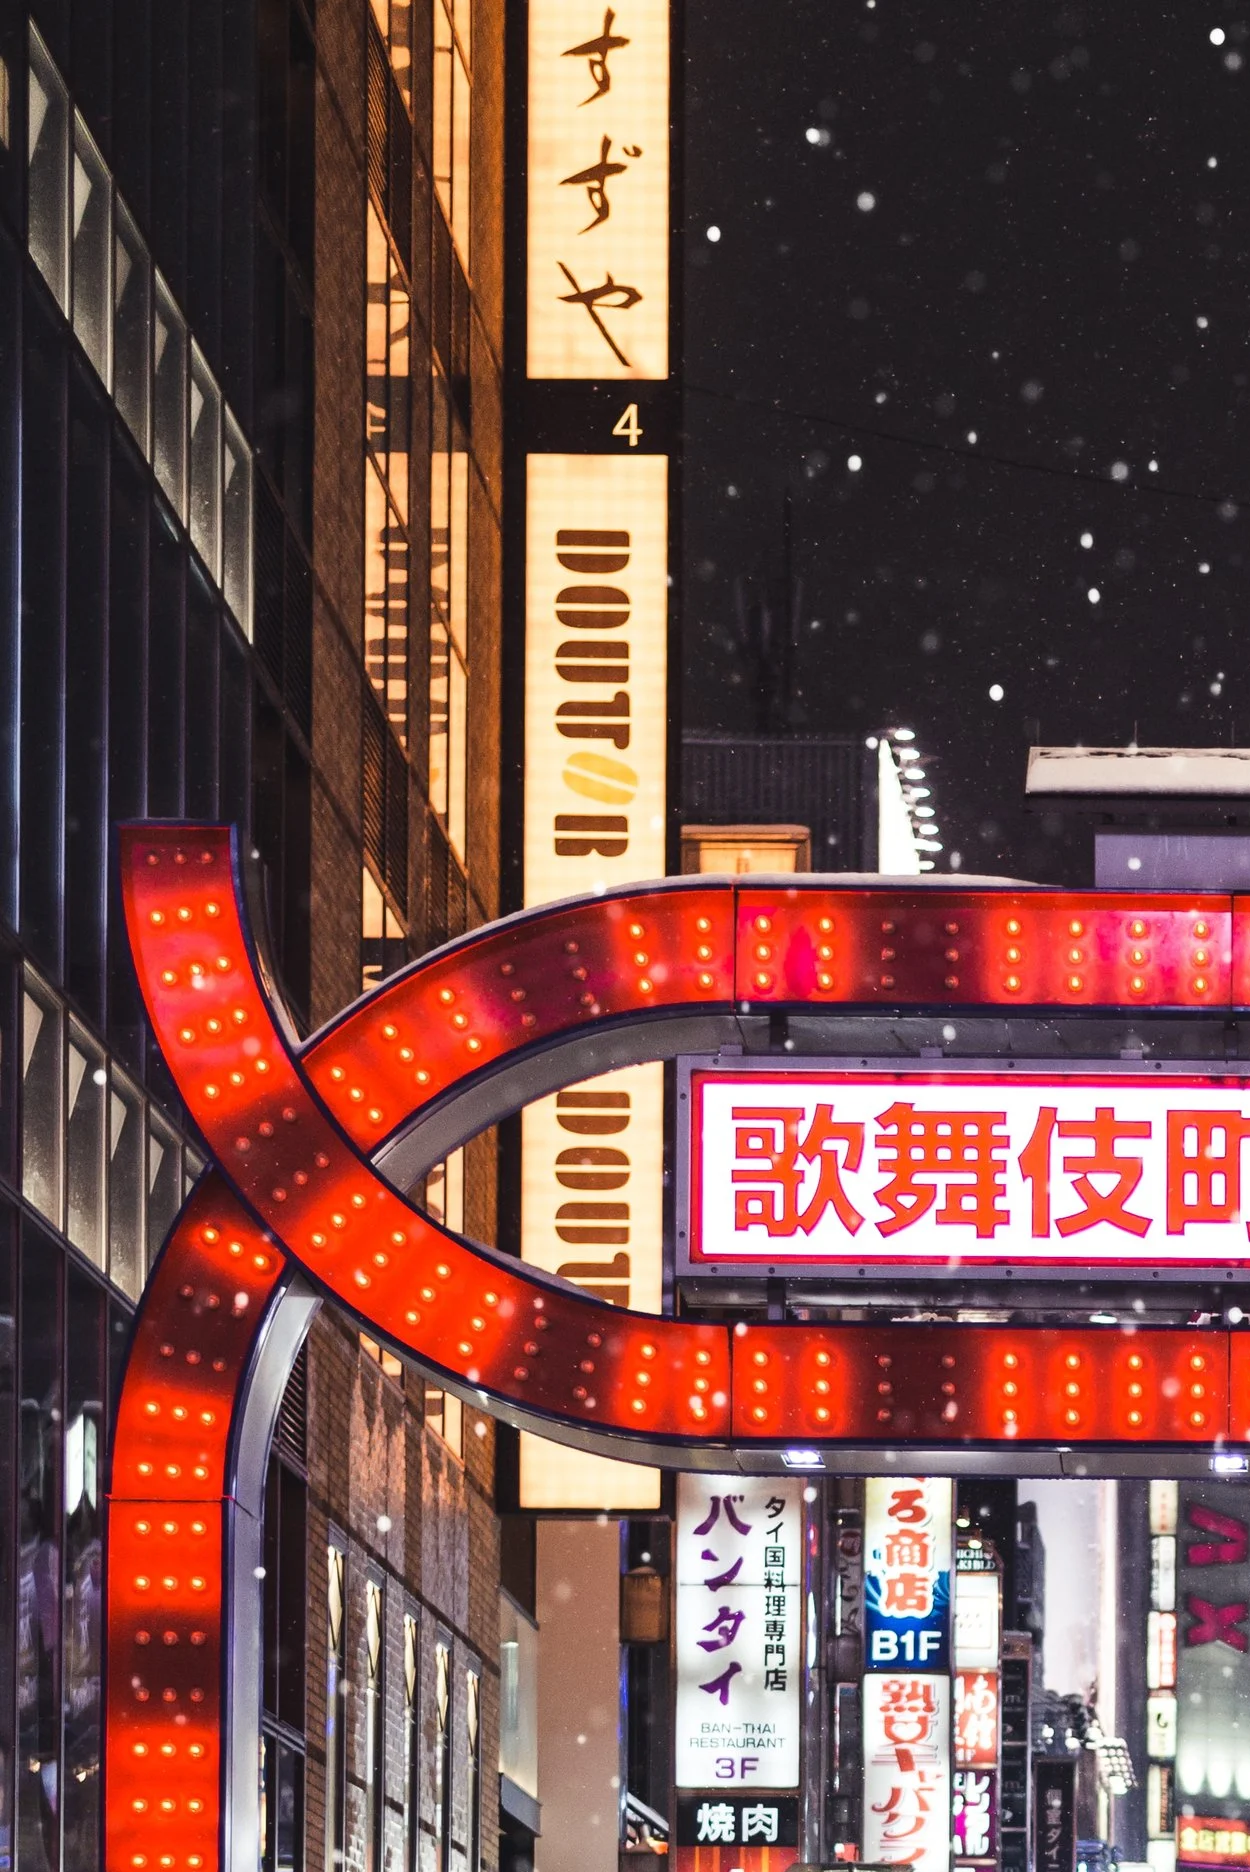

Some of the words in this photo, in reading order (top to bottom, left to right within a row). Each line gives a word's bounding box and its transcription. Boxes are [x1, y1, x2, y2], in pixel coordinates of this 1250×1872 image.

[612, 403, 643, 447] 4
[555, 529, 638, 857] DOUTOR
[884, 1476, 936, 1619] ろ商店
[692, 1494, 753, 1706] バンタイ
[763, 1495, 787, 1693] タイ国料理専門店
[871, 1629, 943, 1662] B1F
[689, 1737, 787, 1750] RESTAURANT
[700, 1721, 777, 1735] BAN-THAI
[715, 1756, 760, 1780] 3F
[696, 1803, 780, 1843] 焼肉
